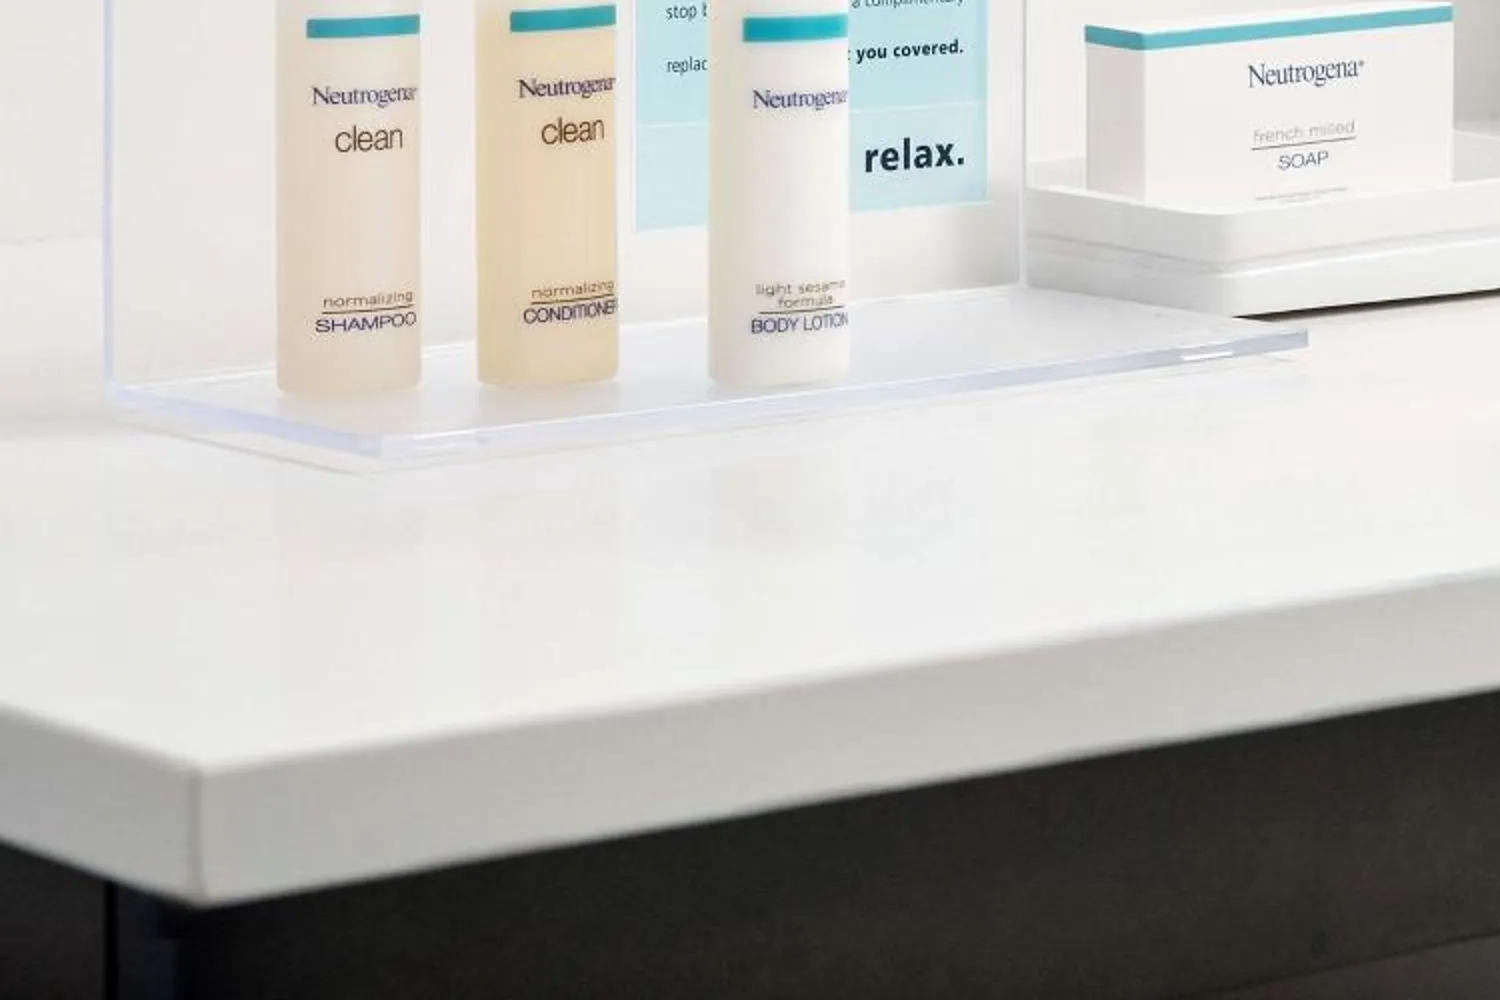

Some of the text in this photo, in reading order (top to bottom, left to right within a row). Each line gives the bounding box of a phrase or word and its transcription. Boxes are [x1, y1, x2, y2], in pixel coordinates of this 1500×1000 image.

[666, 3, 698, 21] stop
[667, 55, 706, 75] replac
[855, 47, 888, 65] you
[893, 38, 964, 59] covered.
[334, 124, 403, 153] clean
[541, 116, 605, 145] clean
[1253, 119, 1356, 144] french milled
[865, 137, 965, 173] relax.
[1277, 150, 1329, 171] SOAP
[323, 290, 413, 309] normalizing
[531, 280, 615, 299] normalizing
[756, 284, 792, 298] light
[777, 294, 834, 309] formula
[315, 311, 416, 333] SHAMPOO
[751, 311, 848, 335] BODY LOTION
